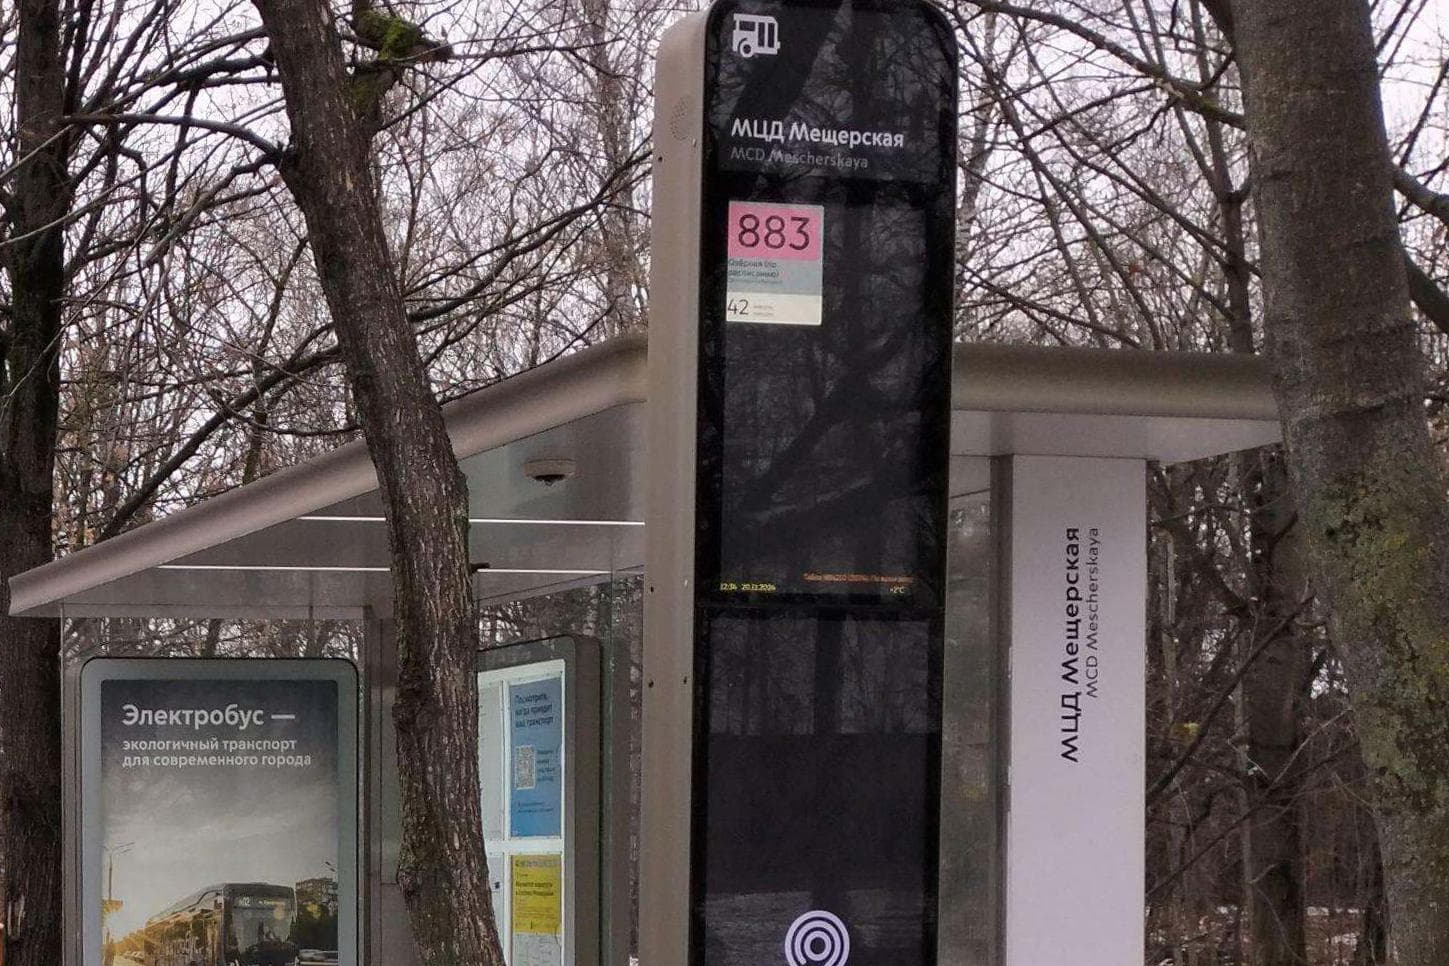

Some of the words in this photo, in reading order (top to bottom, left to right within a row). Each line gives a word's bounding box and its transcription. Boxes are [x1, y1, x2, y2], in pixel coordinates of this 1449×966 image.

[730, 117, 785, 144] МЦД
[789, 120, 904, 149] Мещерская
[730, 147, 766, 162] MCD
[767, 148, 869, 169] Mescherskaya
[738, 214, 811, 251] 883
[727, 298, 750, 316] 42
[1085, 527, 1100, 651] Mescherskaya
[1060, 527, 1083, 686] Мещерская
[1085, 654, 1099, 698] MCD
[121, 703, 265, 729] Электробус
[1060, 690, 1083, 763] МЦД
[122, 736, 219, 750] экологичный
[222, 739, 297, 752] транспорт
[122, 756, 150, 768] для
[153, 755, 258, 768] современного
[261, 754, 311, 767] города
